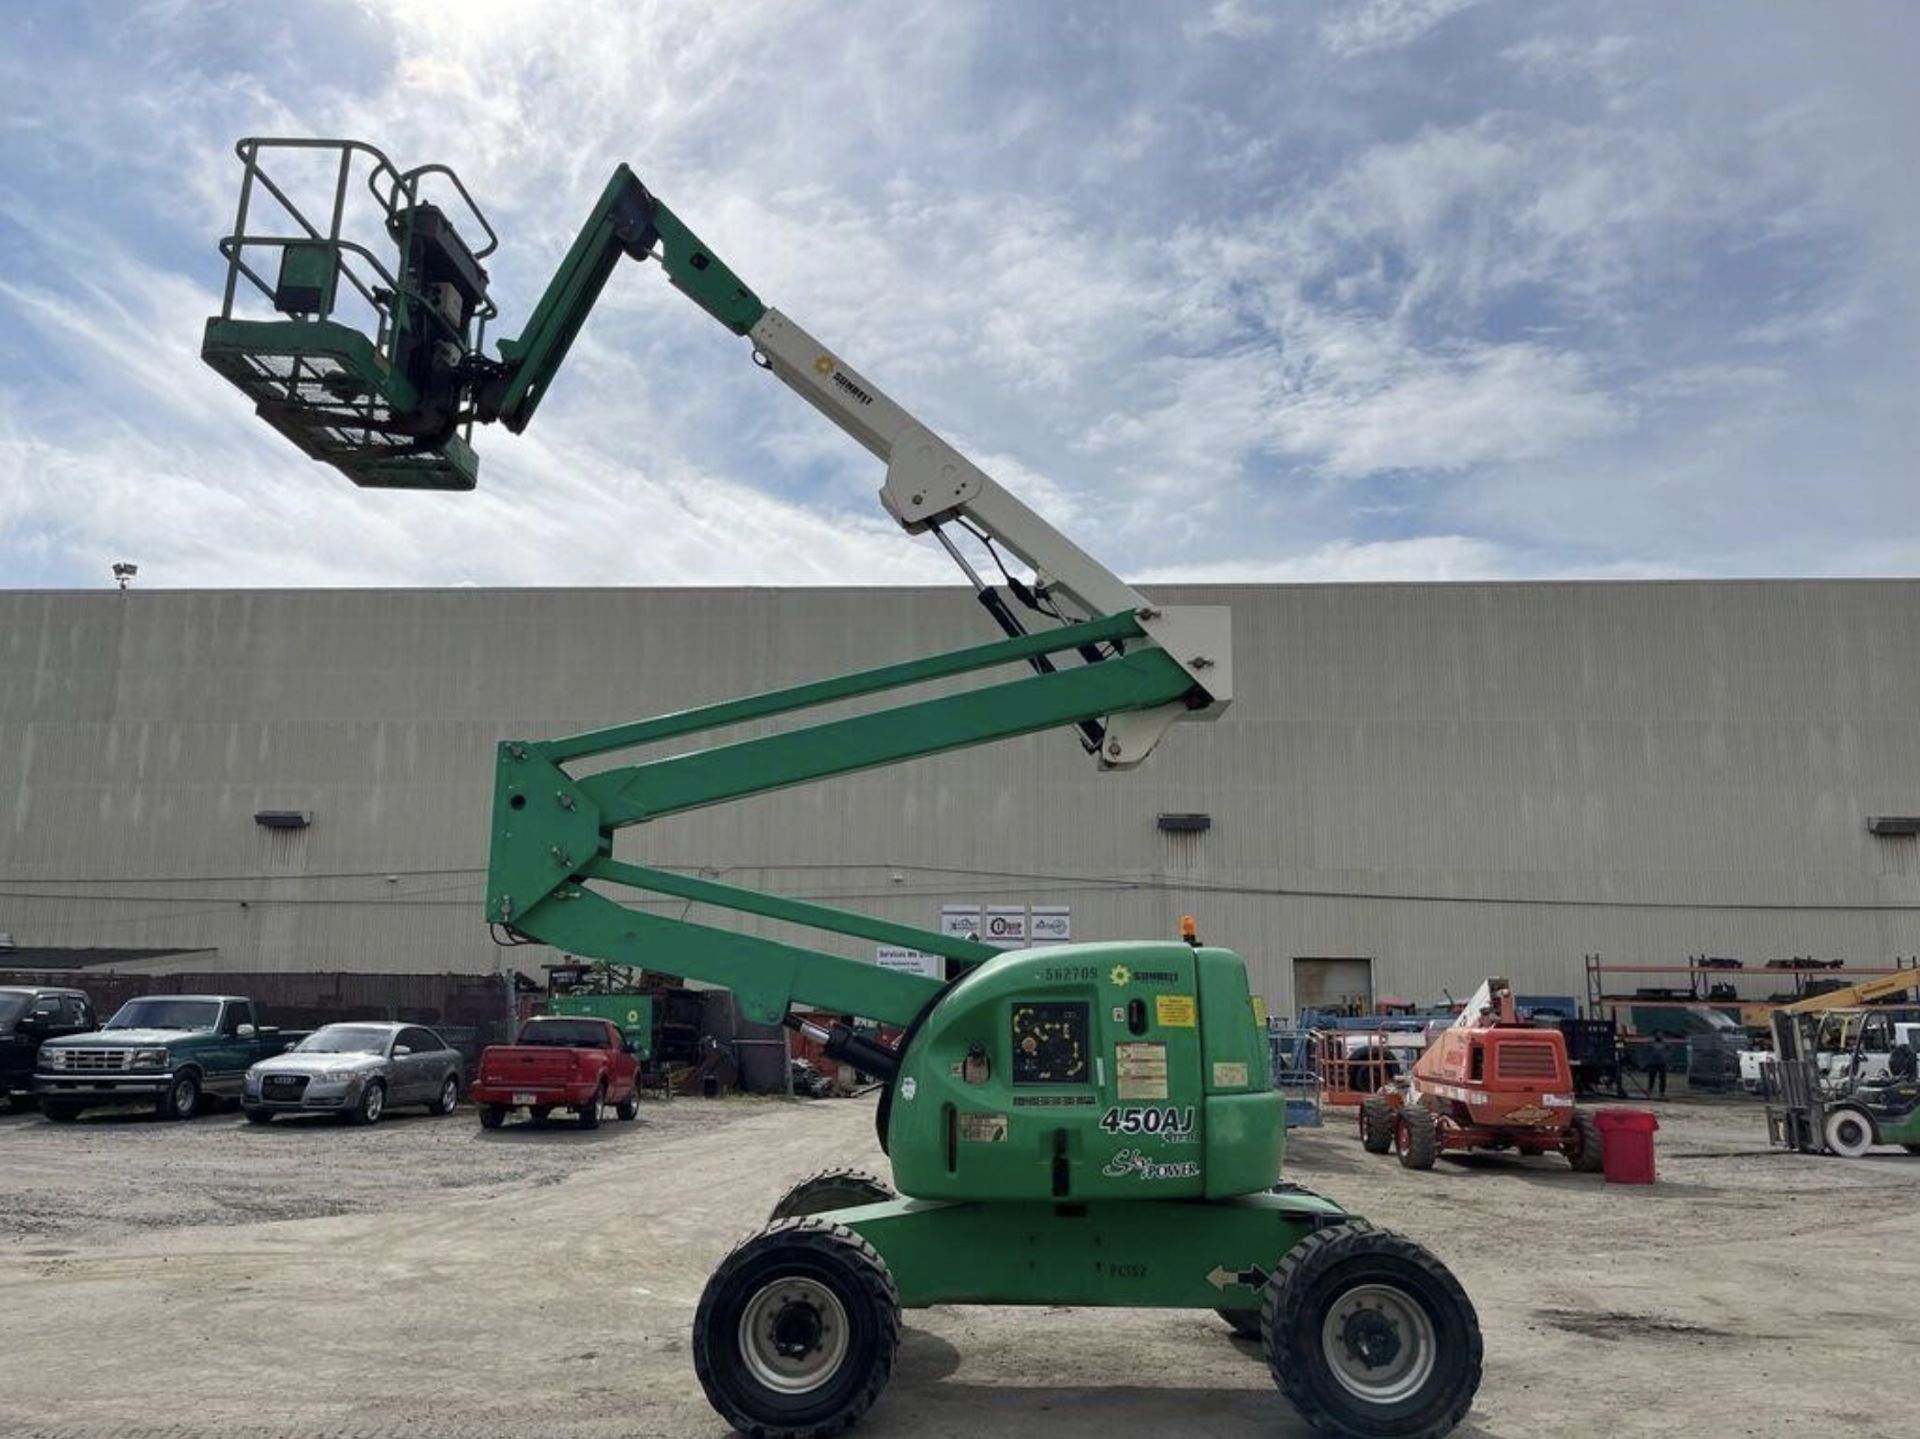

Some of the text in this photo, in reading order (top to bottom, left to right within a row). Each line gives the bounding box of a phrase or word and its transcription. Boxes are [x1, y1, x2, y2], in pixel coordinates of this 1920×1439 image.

[1099, 1106, 1195, 1135] 450AJ
[1102, 1148, 1200, 1179] Sky POWER
